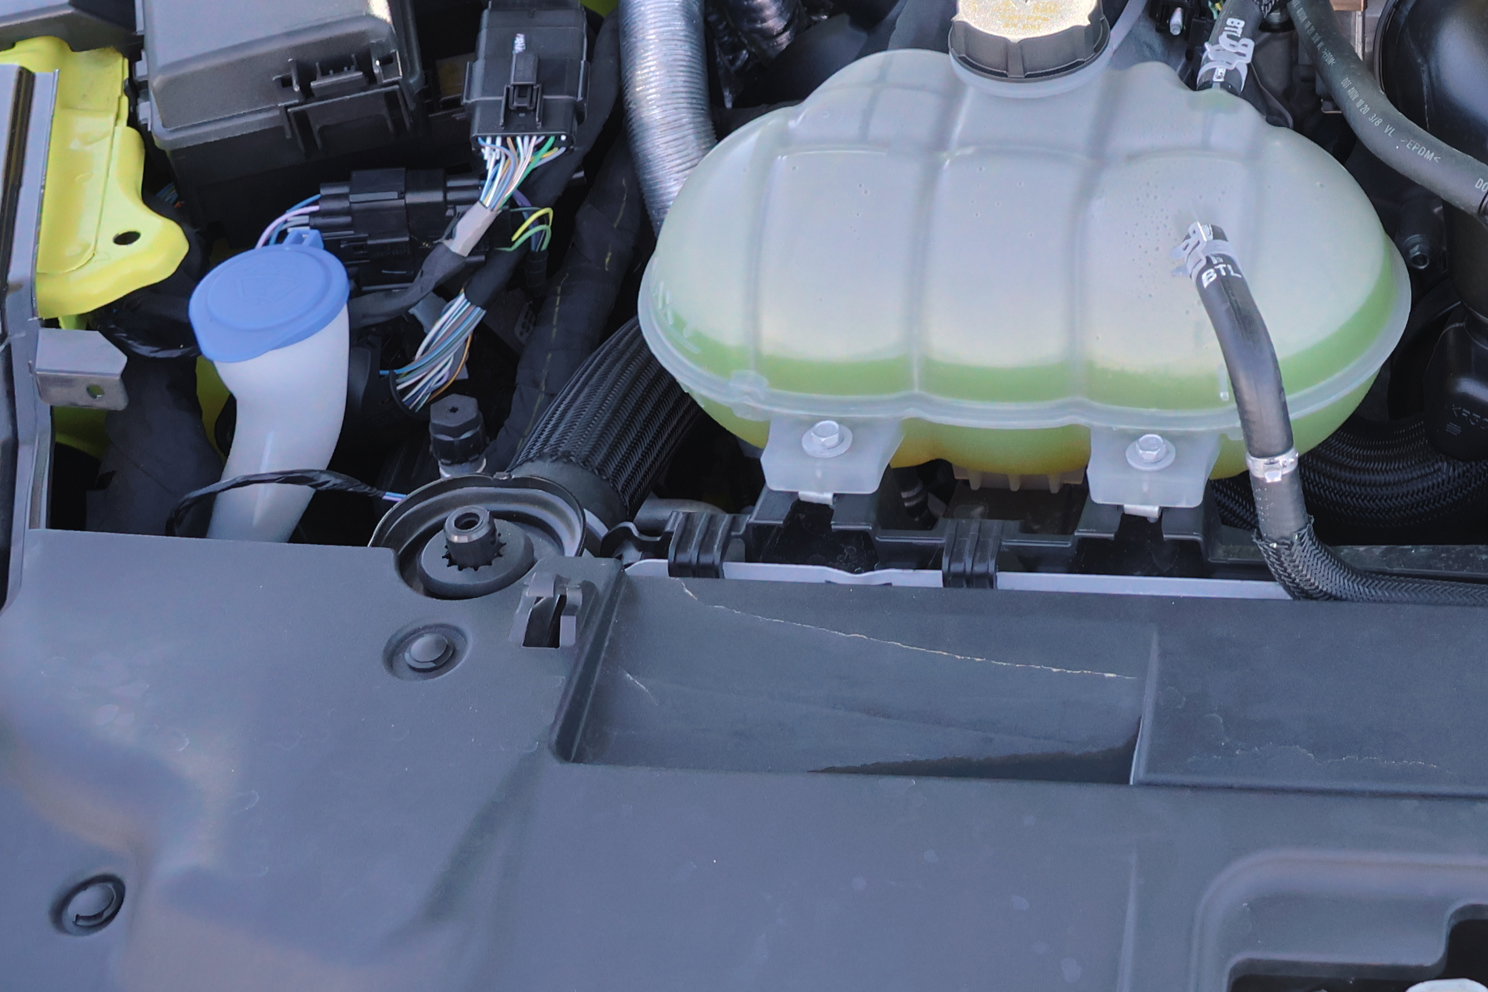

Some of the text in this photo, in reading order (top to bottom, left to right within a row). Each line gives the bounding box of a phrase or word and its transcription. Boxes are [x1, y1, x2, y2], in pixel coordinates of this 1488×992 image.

[1360, 105, 1370, 115] 20
[1368, 113, 1381, 127] 3/8
[1384, 124, 1397, 138] VL
[1400, 139, 1442, 164] >EPDM<
[1201, 263, 1242, 289] BTL
